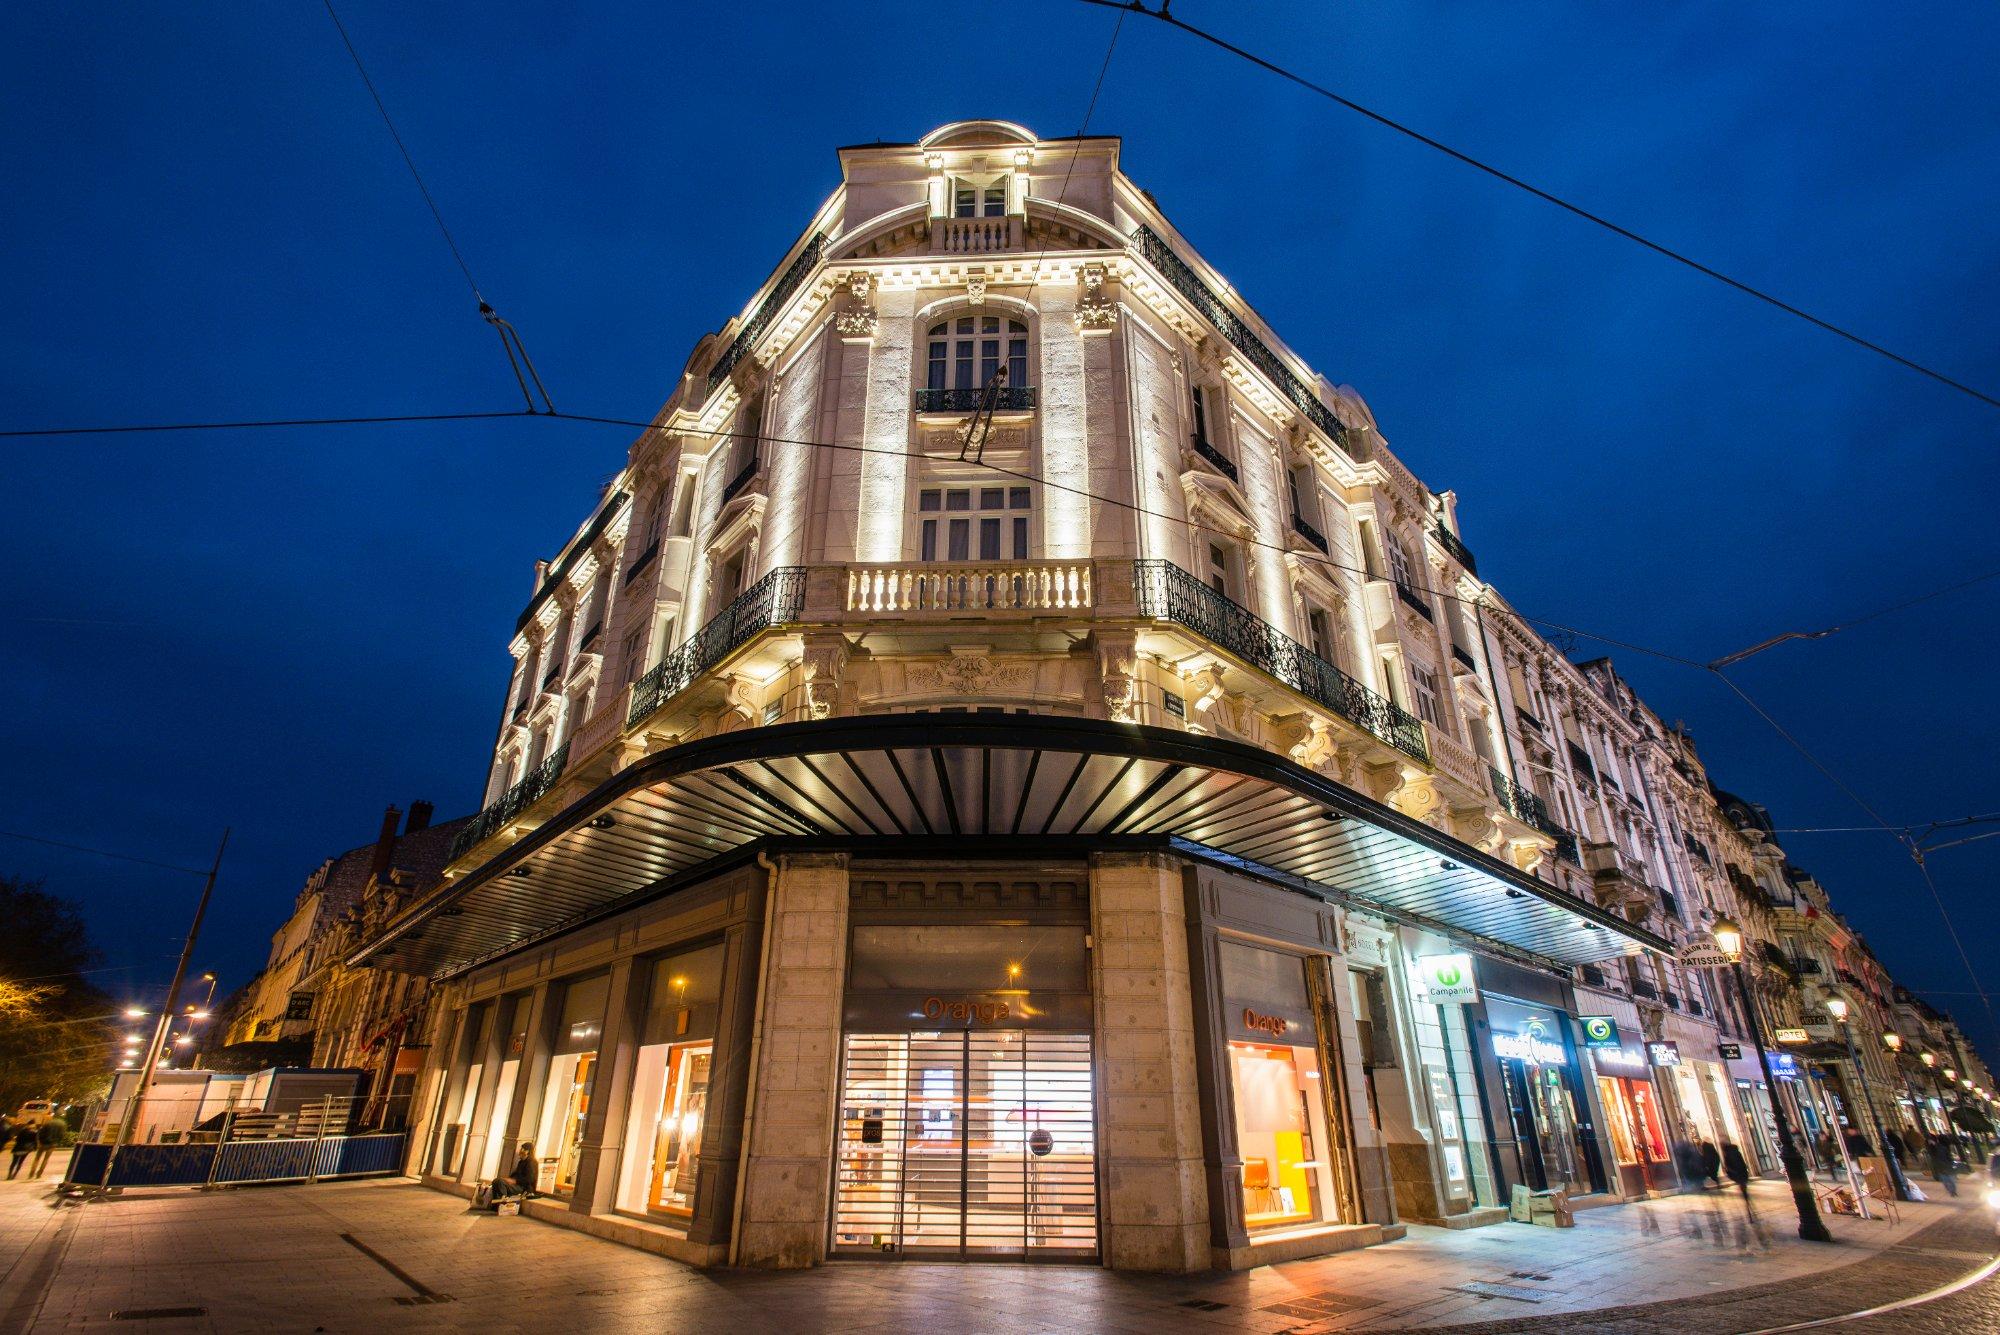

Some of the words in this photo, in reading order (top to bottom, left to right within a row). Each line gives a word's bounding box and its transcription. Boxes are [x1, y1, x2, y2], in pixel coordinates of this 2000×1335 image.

[1681, 943, 1702, 957] SALON
[1430, 985, 1474, 998] Campanile
[923, 996, 1010, 1026] Orange
[1243, 1007, 1287, 1039] Orange
[1777, 1030, 1807, 1040] HOTEL
